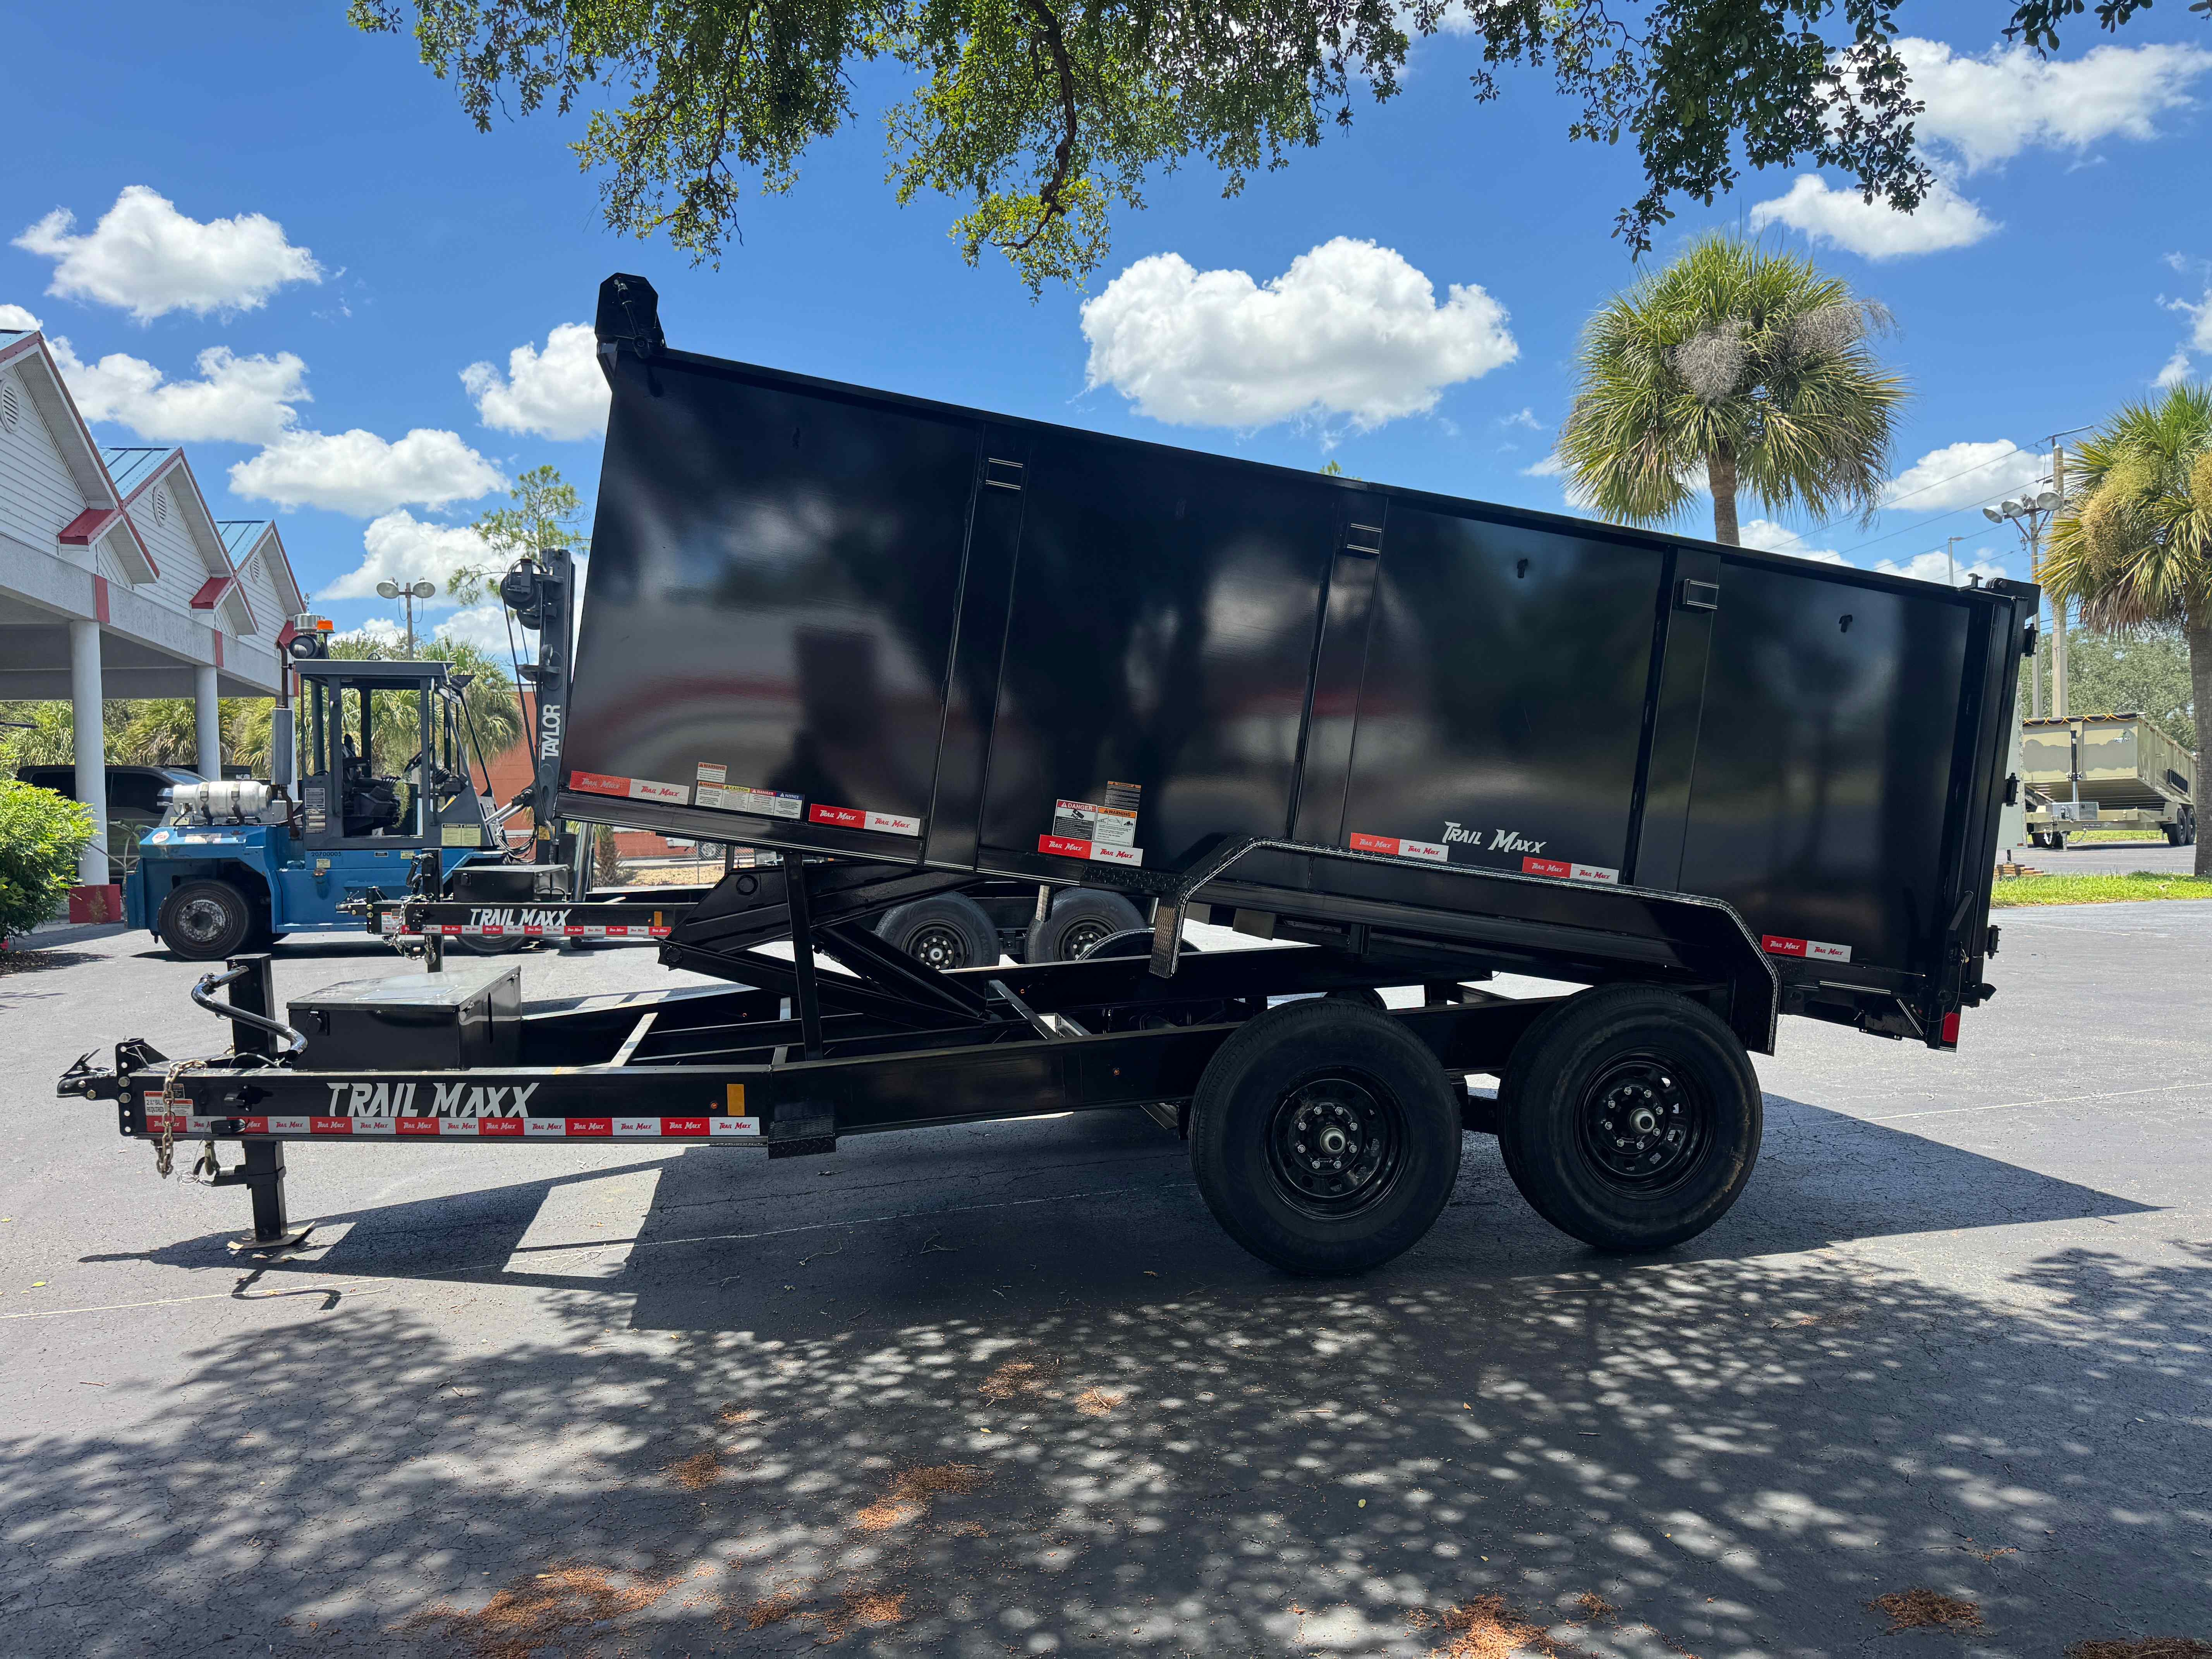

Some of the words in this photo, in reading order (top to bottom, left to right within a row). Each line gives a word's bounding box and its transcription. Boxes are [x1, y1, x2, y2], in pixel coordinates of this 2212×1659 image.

[541, 704, 560, 760] TAYLOR
[641, 786, 656, 794] TRAIL
[659, 788, 680, 797] MAXX
[1068, 803, 1092, 811] DANGER
[836, 812, 856, 821] MAXX
[891, 820, 910, 828] MAXX
[1442, 821, 1482, 845] TRAIL
[1487, 829, 1547, 854] MAXX
[1065, 842, 1083, 851] MAXX
[1116, 850, 1134, 859] MAXX
[470, 908, 514, 926] TRAIL
[518, 908, 572, 926] MAXX
[326, 1083, 419, 1117] TRAIL
[427, 1082, 540, 1118] MAXX
